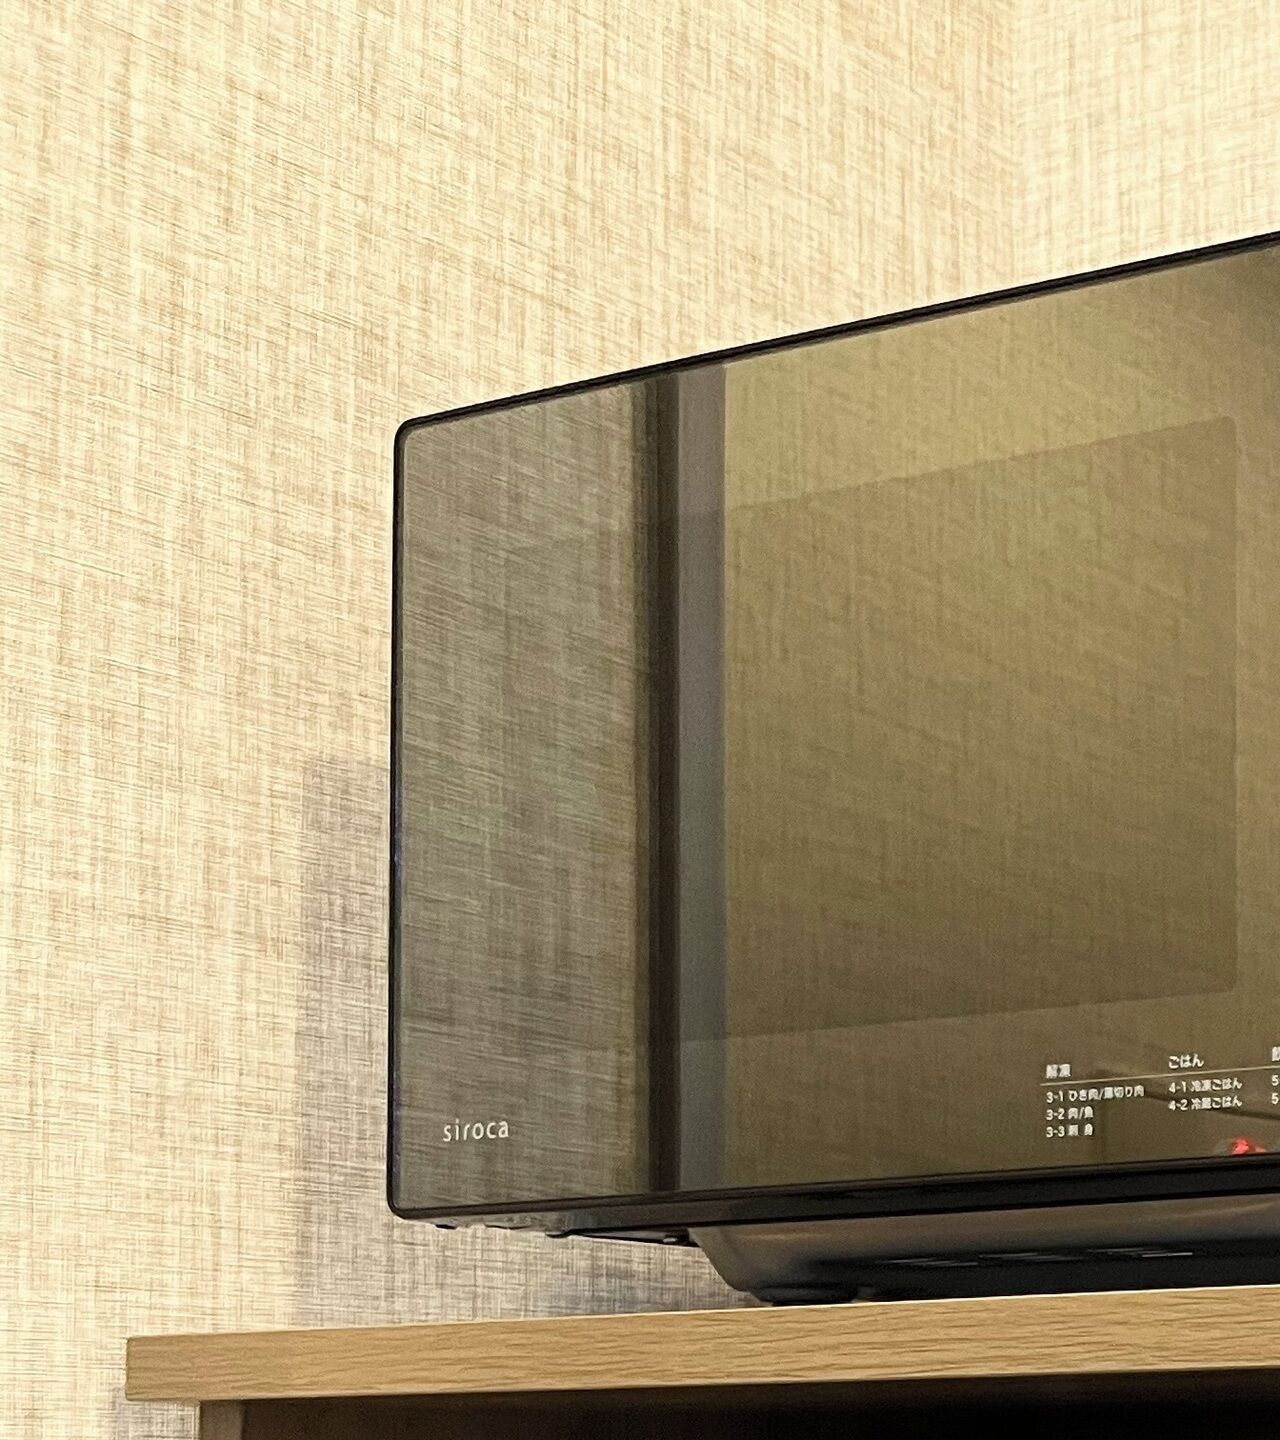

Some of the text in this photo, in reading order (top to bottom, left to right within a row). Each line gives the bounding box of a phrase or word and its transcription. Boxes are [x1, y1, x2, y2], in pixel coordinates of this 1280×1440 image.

[1169, 1053, 1204, 1068] ごはん
[1169, 1081, 1187, 1093] 4-1
[1046, 1085, 1144, 1103] 3-1 ひき肉/切り肉
[1168, 1098, 1188, 1111] 4-2
[1046, 1108, 1065, 1120] 3-2
[443, 1118, 509, 1142] siroca
[1046, 1125, 1065, 1138] 3-3
